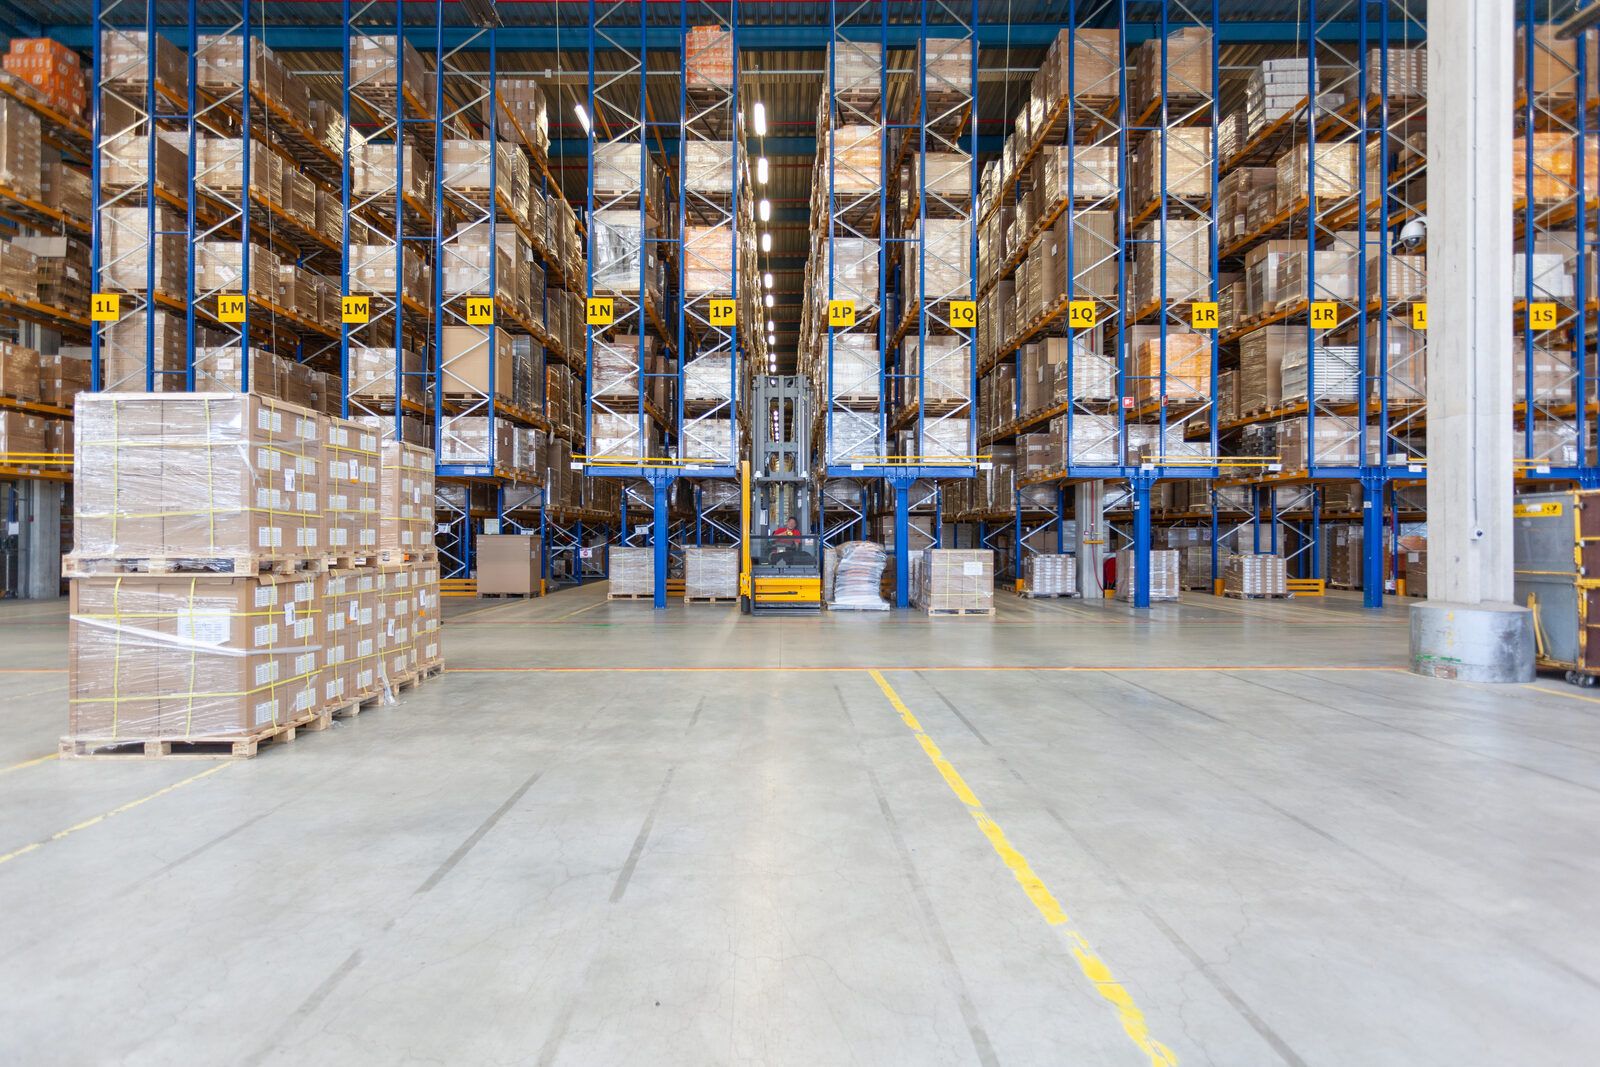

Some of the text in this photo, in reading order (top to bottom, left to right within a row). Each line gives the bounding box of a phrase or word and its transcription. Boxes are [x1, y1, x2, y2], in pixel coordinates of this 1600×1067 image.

[96, 301, 115, 313] 1L
[221, 302, 244, 314] 1M
[344, 303, 367, 315] 1M
[469, 305, 491, 317] 1N
[589, 305, 611, 317] 1N
[713, 306, 733, 318] 1P
[832, 307, 852, 318] 1P
[953, 308, 974, 322] 1Q
[1071, 308, 1093, 322] 1Q
[1196, 310, 1216, 321] 1R
[1314, 309, 1334, 321] 1R
[1418, 310, 1425, 322] 1
[1534, 310, 1553, 322] 1S
